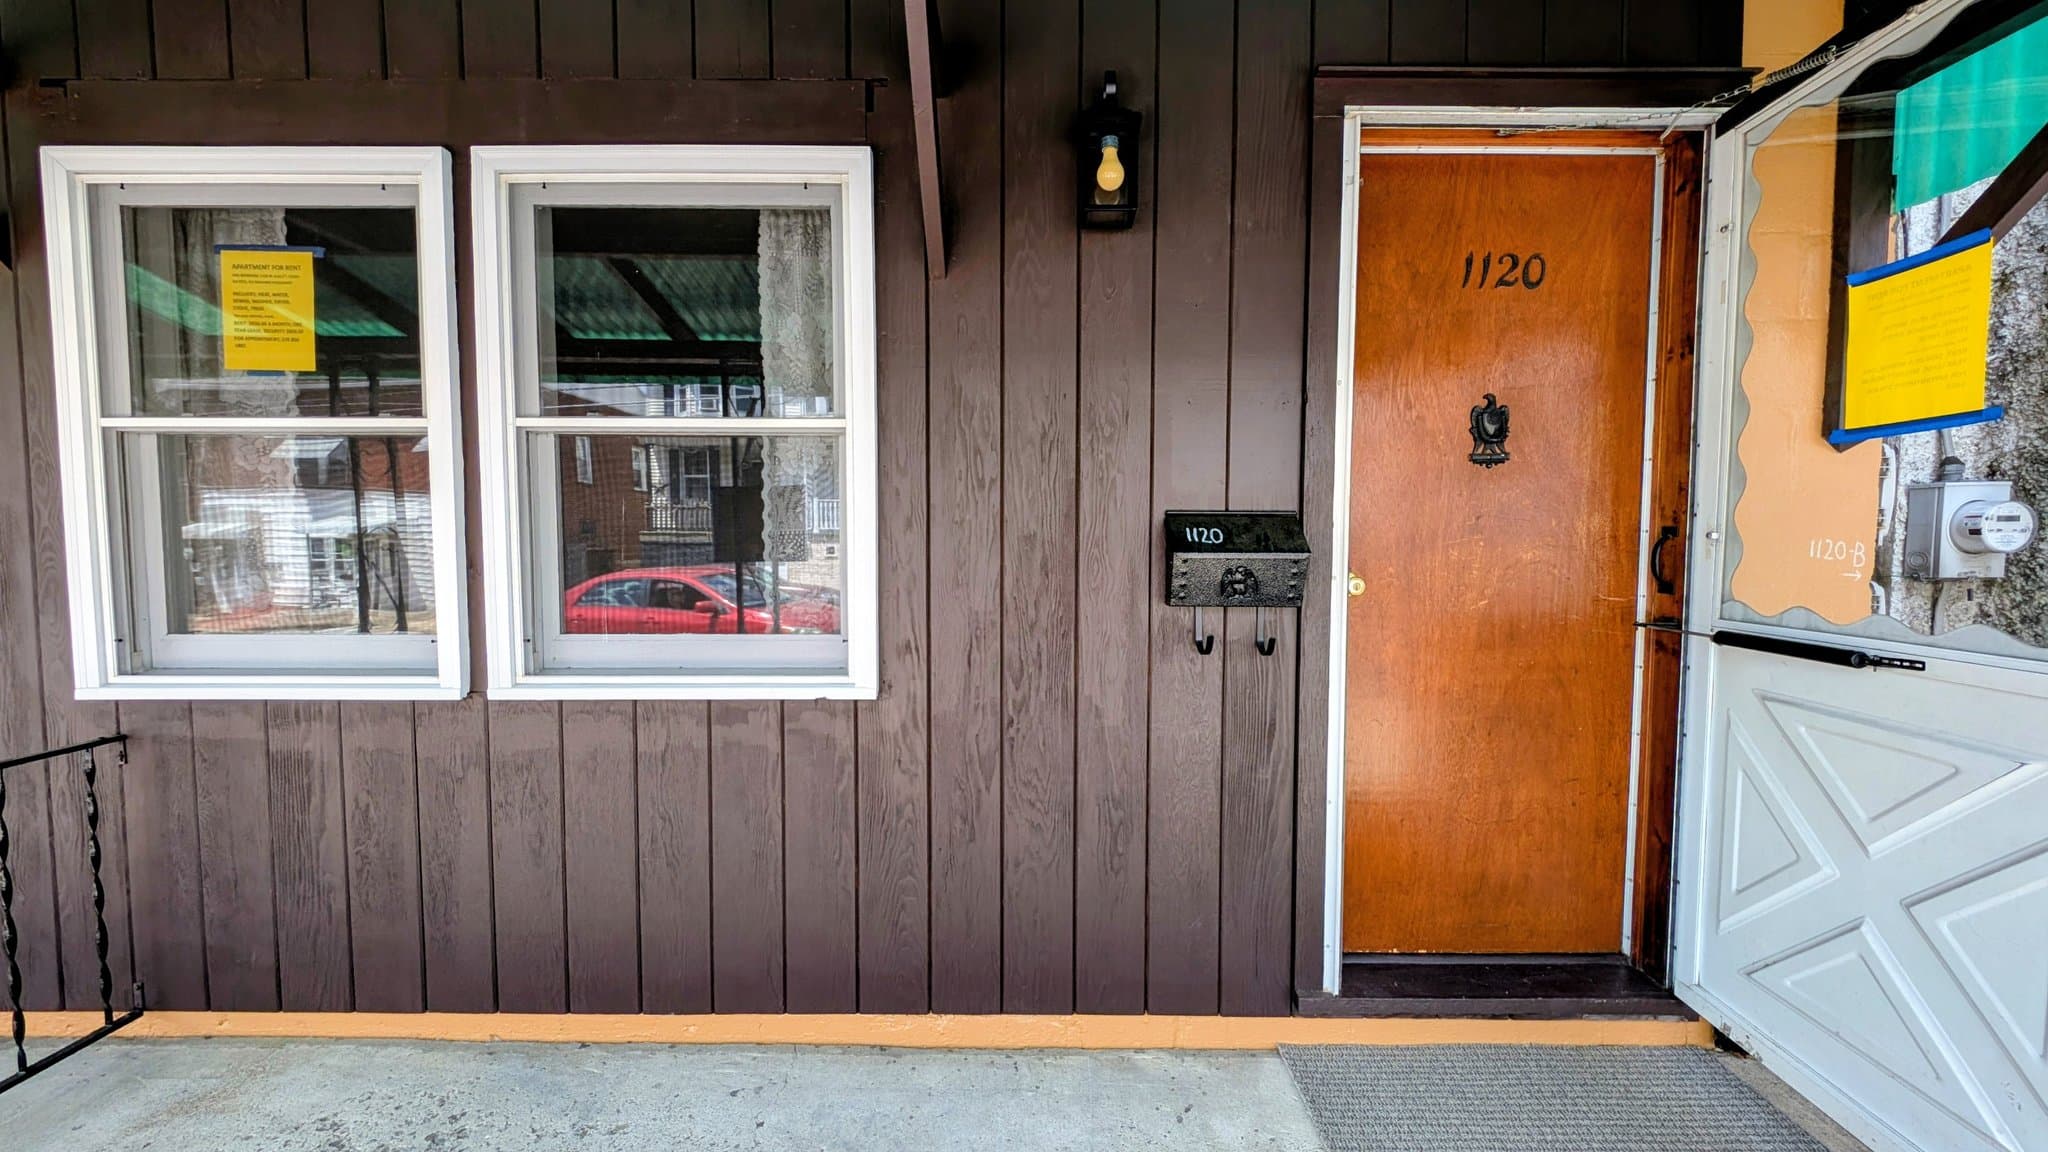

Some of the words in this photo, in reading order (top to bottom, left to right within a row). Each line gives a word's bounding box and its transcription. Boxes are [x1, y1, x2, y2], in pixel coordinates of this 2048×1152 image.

[232, 263, 270, 271] APARTMENT
[1462, 251, 1546, 289] 1120
[1185, 527, 1224, 544] 1120
[1809, 538, 1866, 568] 1120-B
